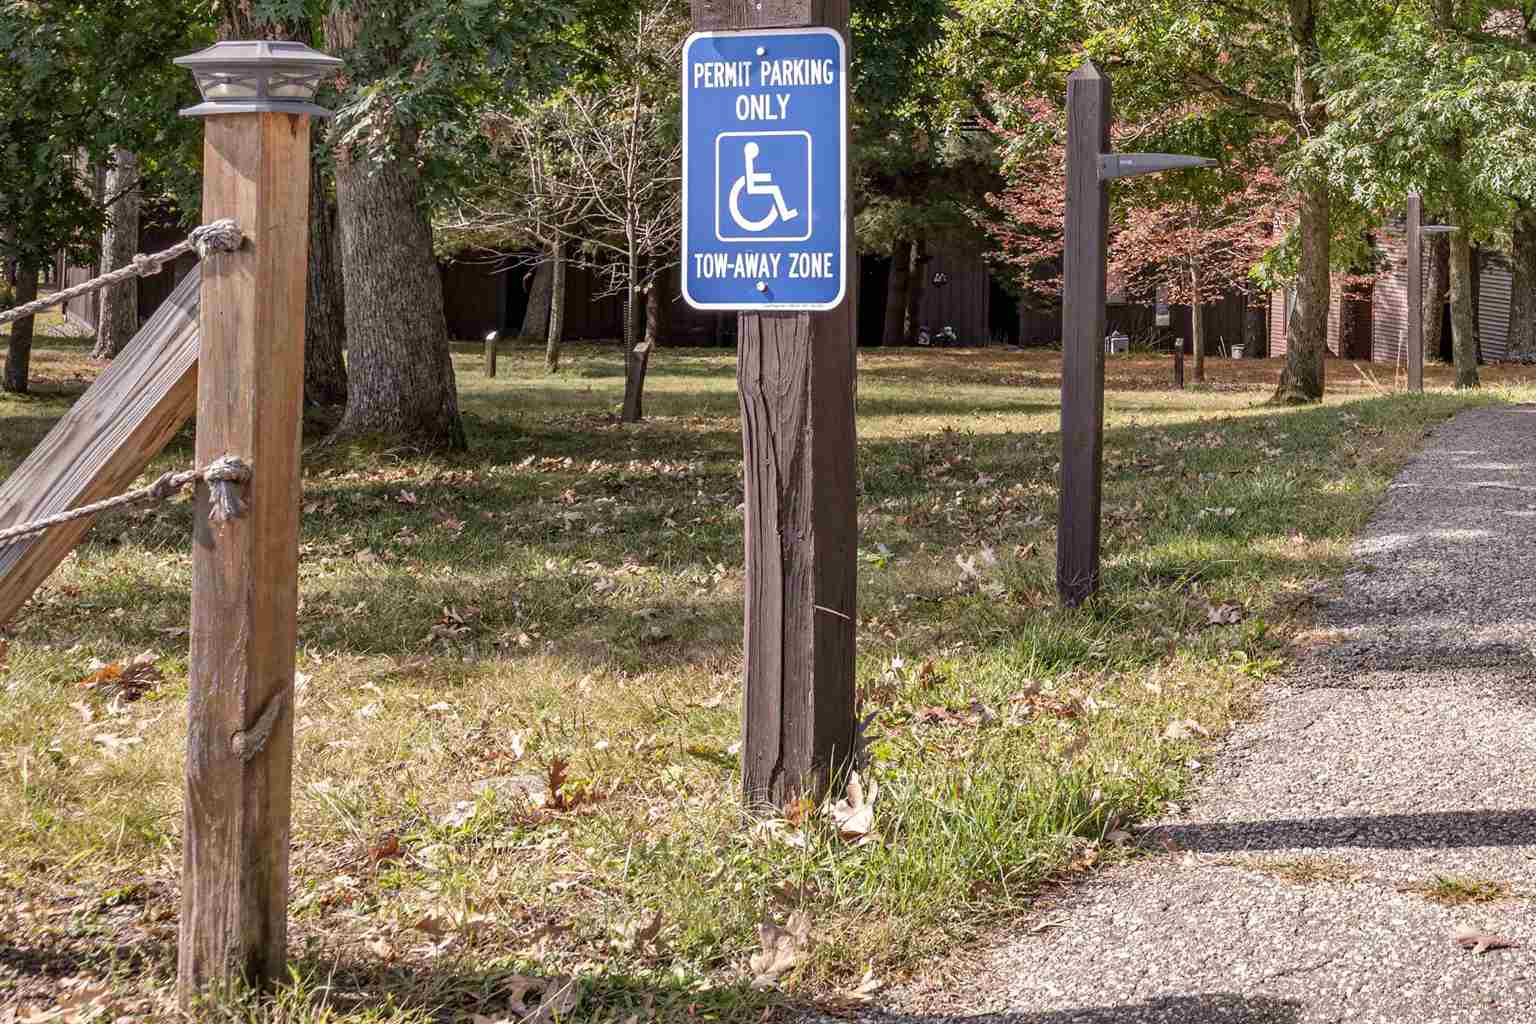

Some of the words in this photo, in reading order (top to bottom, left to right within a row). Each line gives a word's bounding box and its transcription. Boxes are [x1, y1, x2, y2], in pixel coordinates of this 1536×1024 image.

[694, 61, 752, 88] PERMIT
[761, 59, 833, 86] PARKING
[735, 93, 791, 121] ONLY
[694, 252, 781, 278] TOW-AWAY
[788, 252, 834, 278] ZONE
